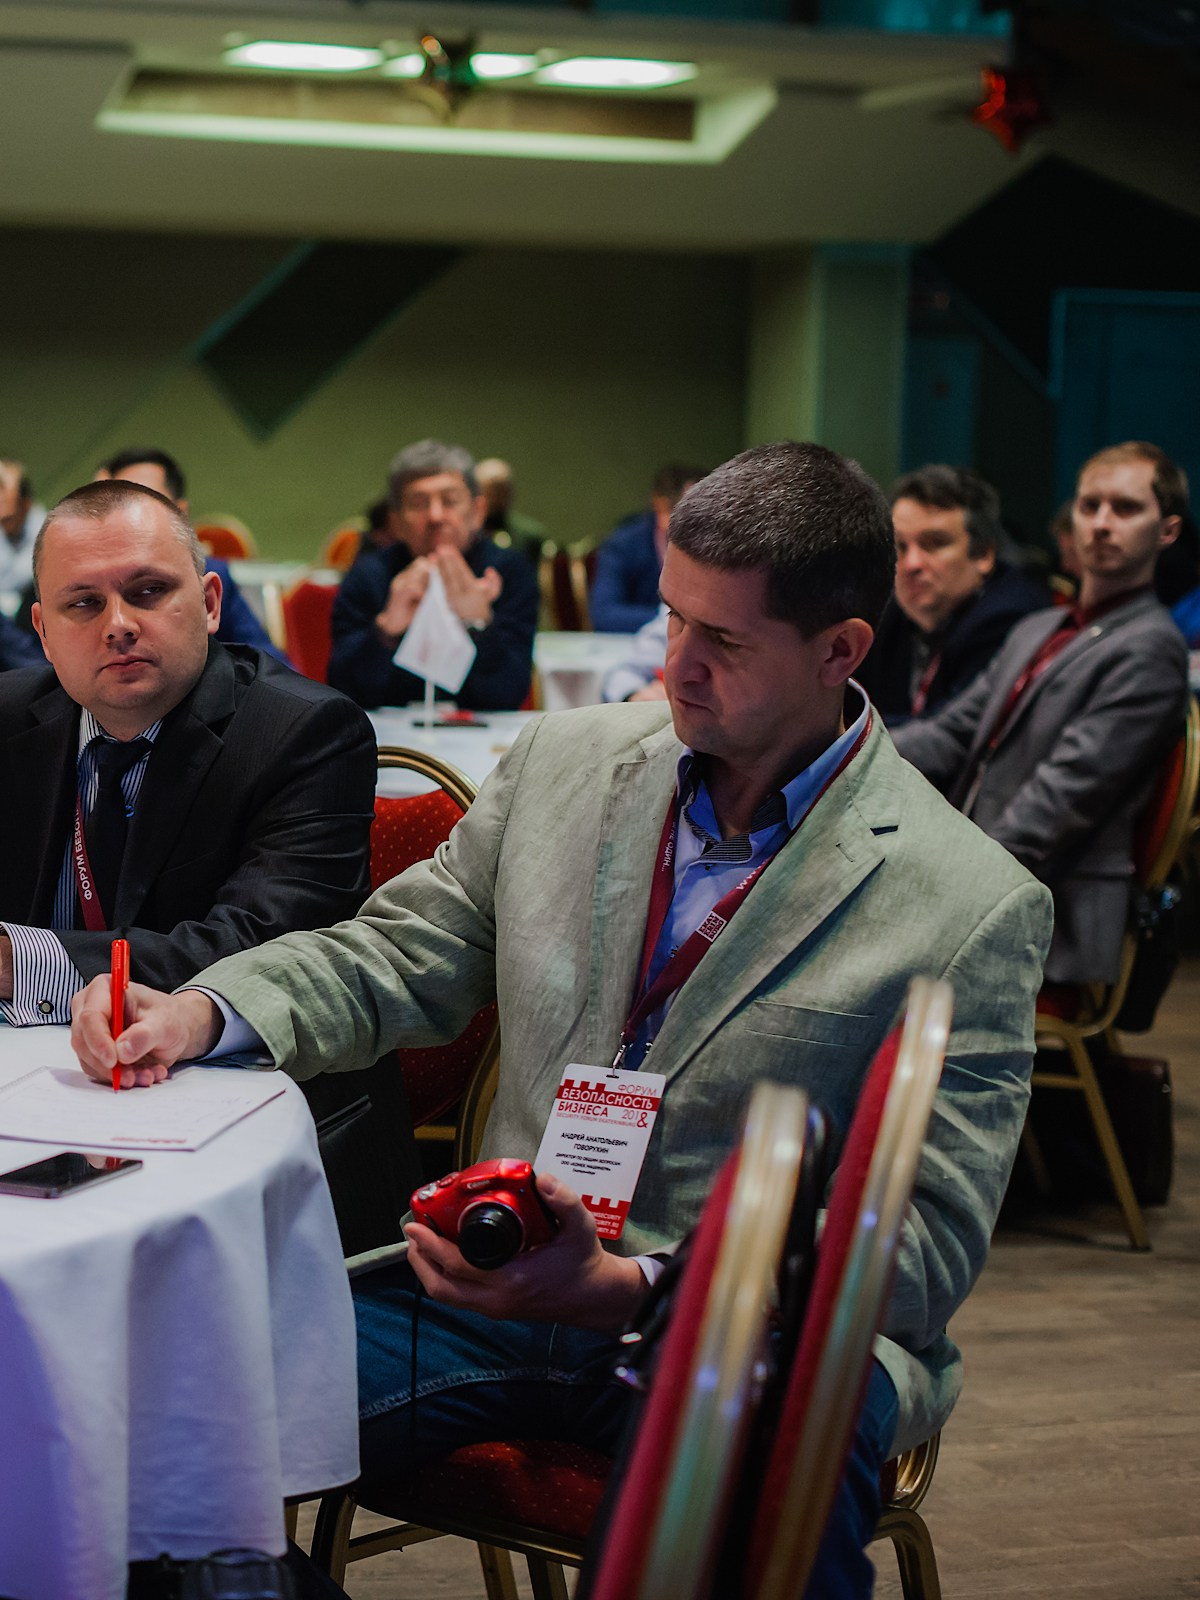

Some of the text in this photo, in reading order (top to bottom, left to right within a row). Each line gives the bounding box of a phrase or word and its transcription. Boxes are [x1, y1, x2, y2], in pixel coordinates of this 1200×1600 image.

[76, 854, 93, 900] ФОРУМ
[618, 1084, 657, 1096] ФОРУМ
[562, 1088, 653, 1109] БЕЗОПАСНОСТЬ
[558, 1101, 608, 1117] БИЗНЕСА
[560, 1132, 628, 1146] АНДРЕЙ АНАТОЛЬЕВИЧ
[573, 1143, 609, 1153] ГОВОРУХИН
